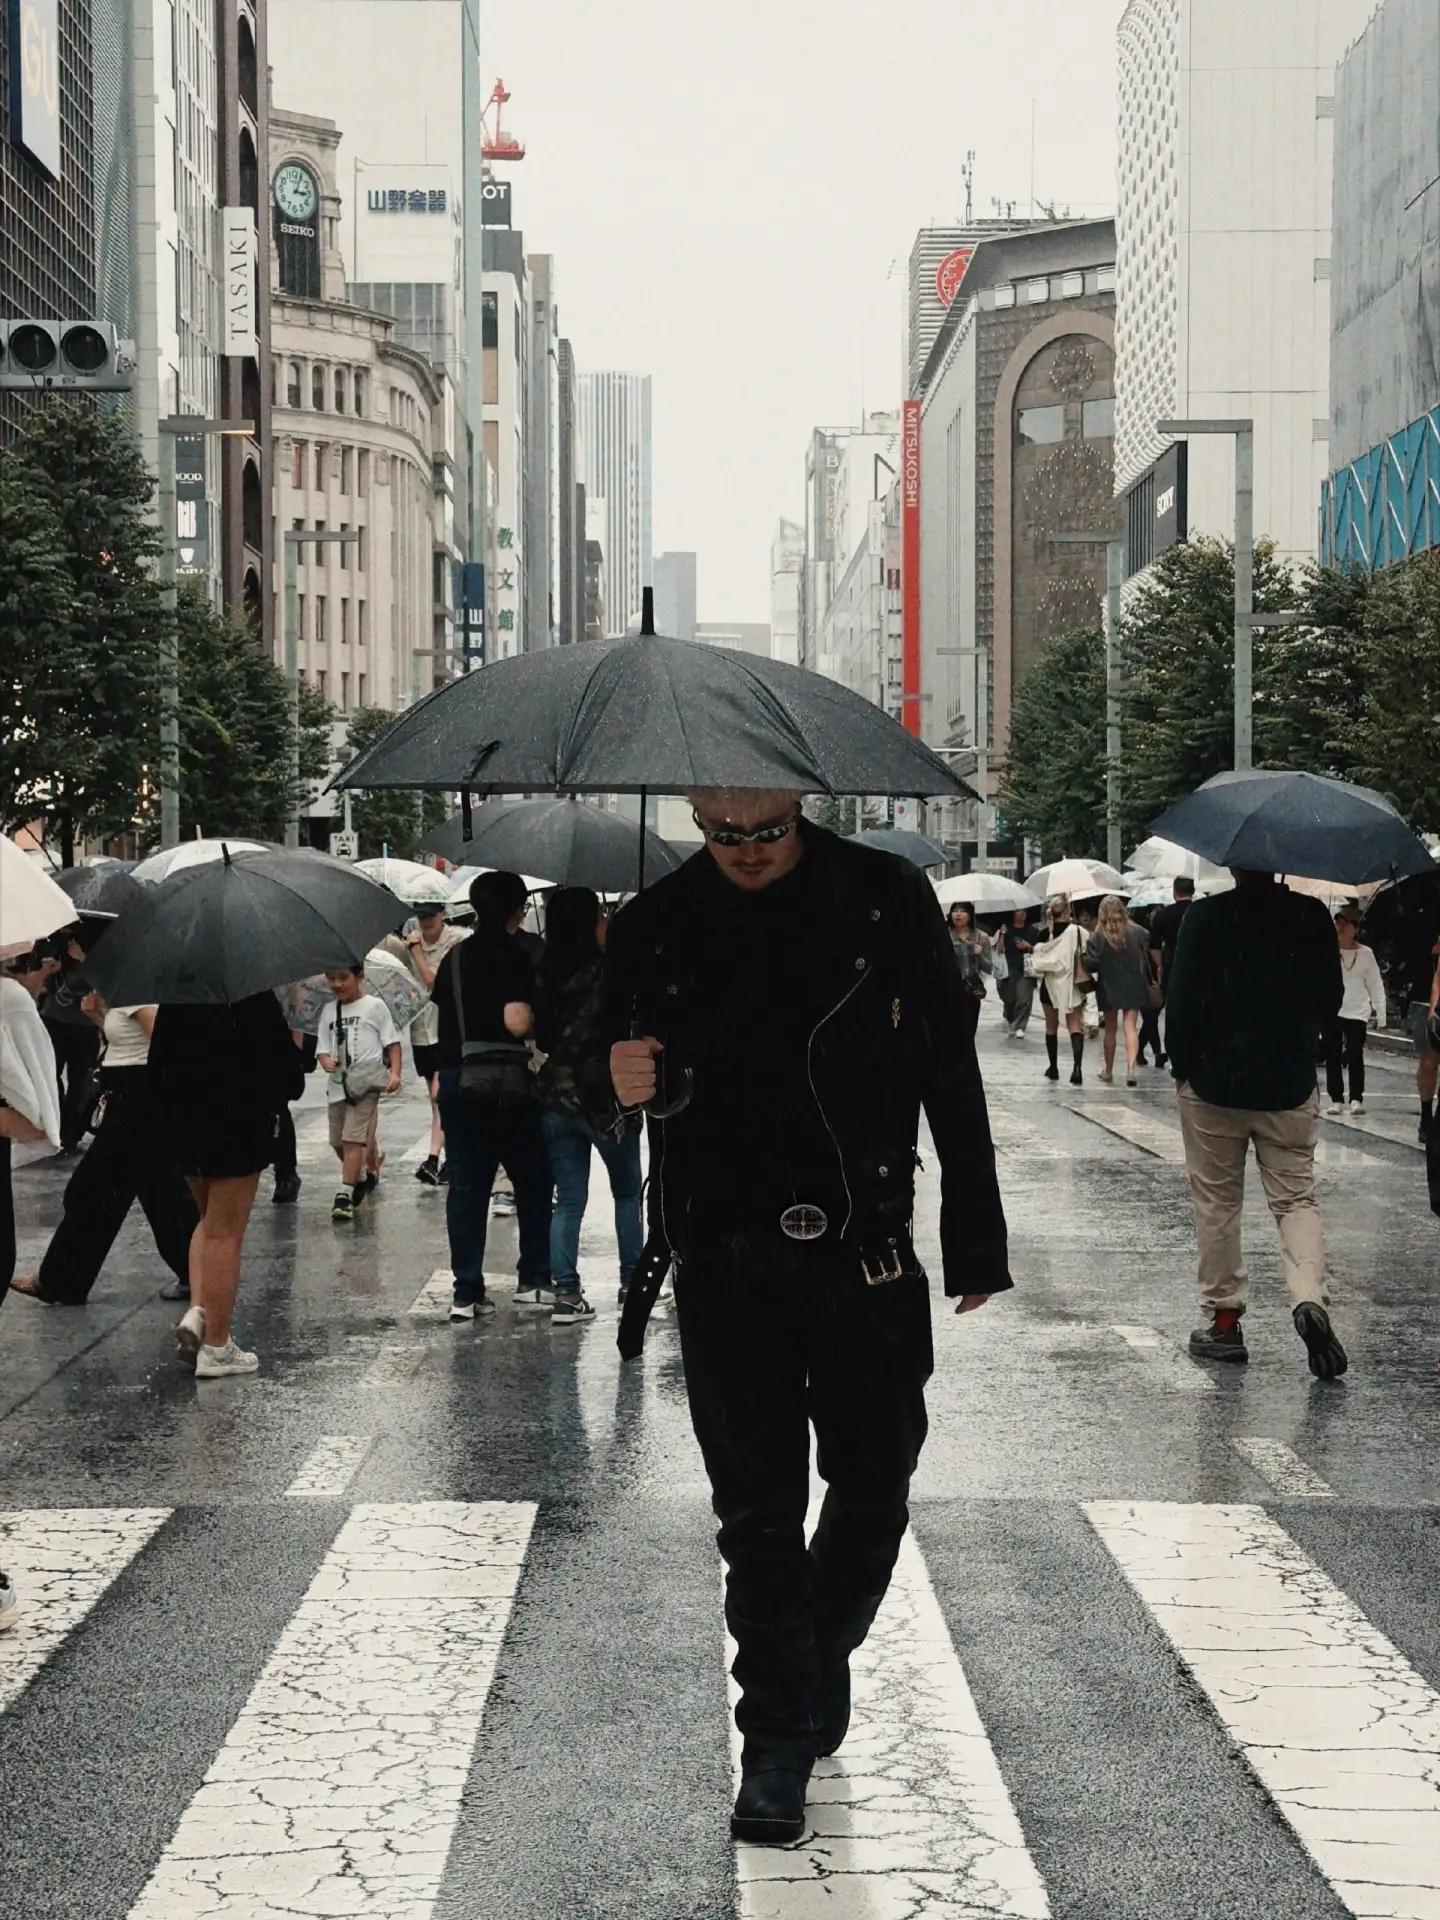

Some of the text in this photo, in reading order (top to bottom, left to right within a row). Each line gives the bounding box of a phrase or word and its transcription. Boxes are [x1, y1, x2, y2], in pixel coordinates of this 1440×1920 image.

[23, 3, 58, 118] GU
[367, 188, 447, 212] 山野楽器
[481, 185, 508, 199] OT
[280, 223, 315, 238] SEIKO
[230, 223, 248, 341] TASAKI
[906, 407, 918, 508] MITSUKOSHI
[497, 526, 514, 632] 教文館
[333, 835, 355, 843] TAXI
